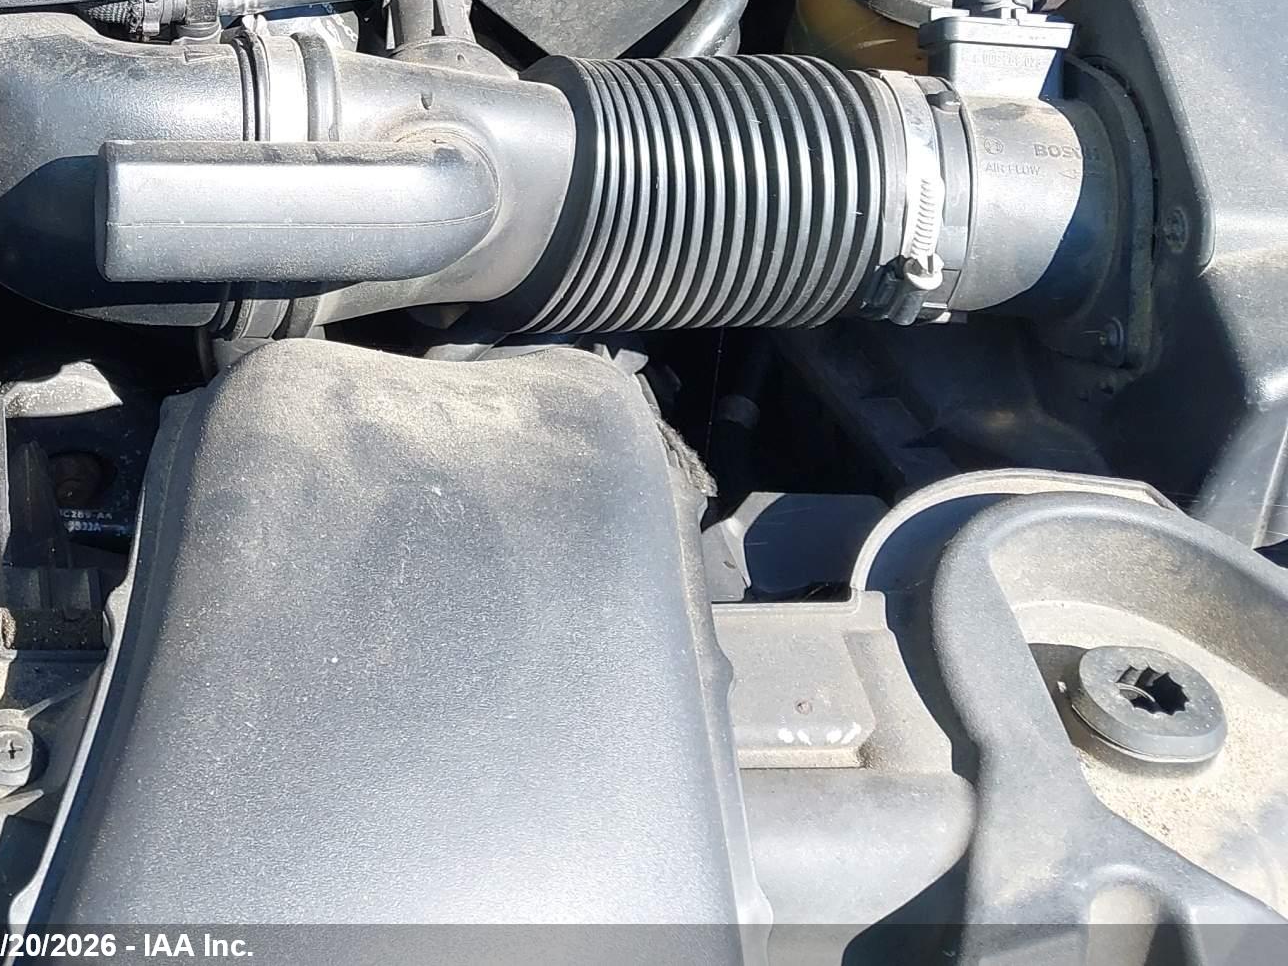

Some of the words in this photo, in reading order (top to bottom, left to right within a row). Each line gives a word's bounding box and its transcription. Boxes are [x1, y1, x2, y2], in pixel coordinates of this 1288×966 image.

[1033, 143, 1101, 162] BOSCH
[985, 163, 1004, 173] AIR
[1008, 164, 1041, 176] FLOW
